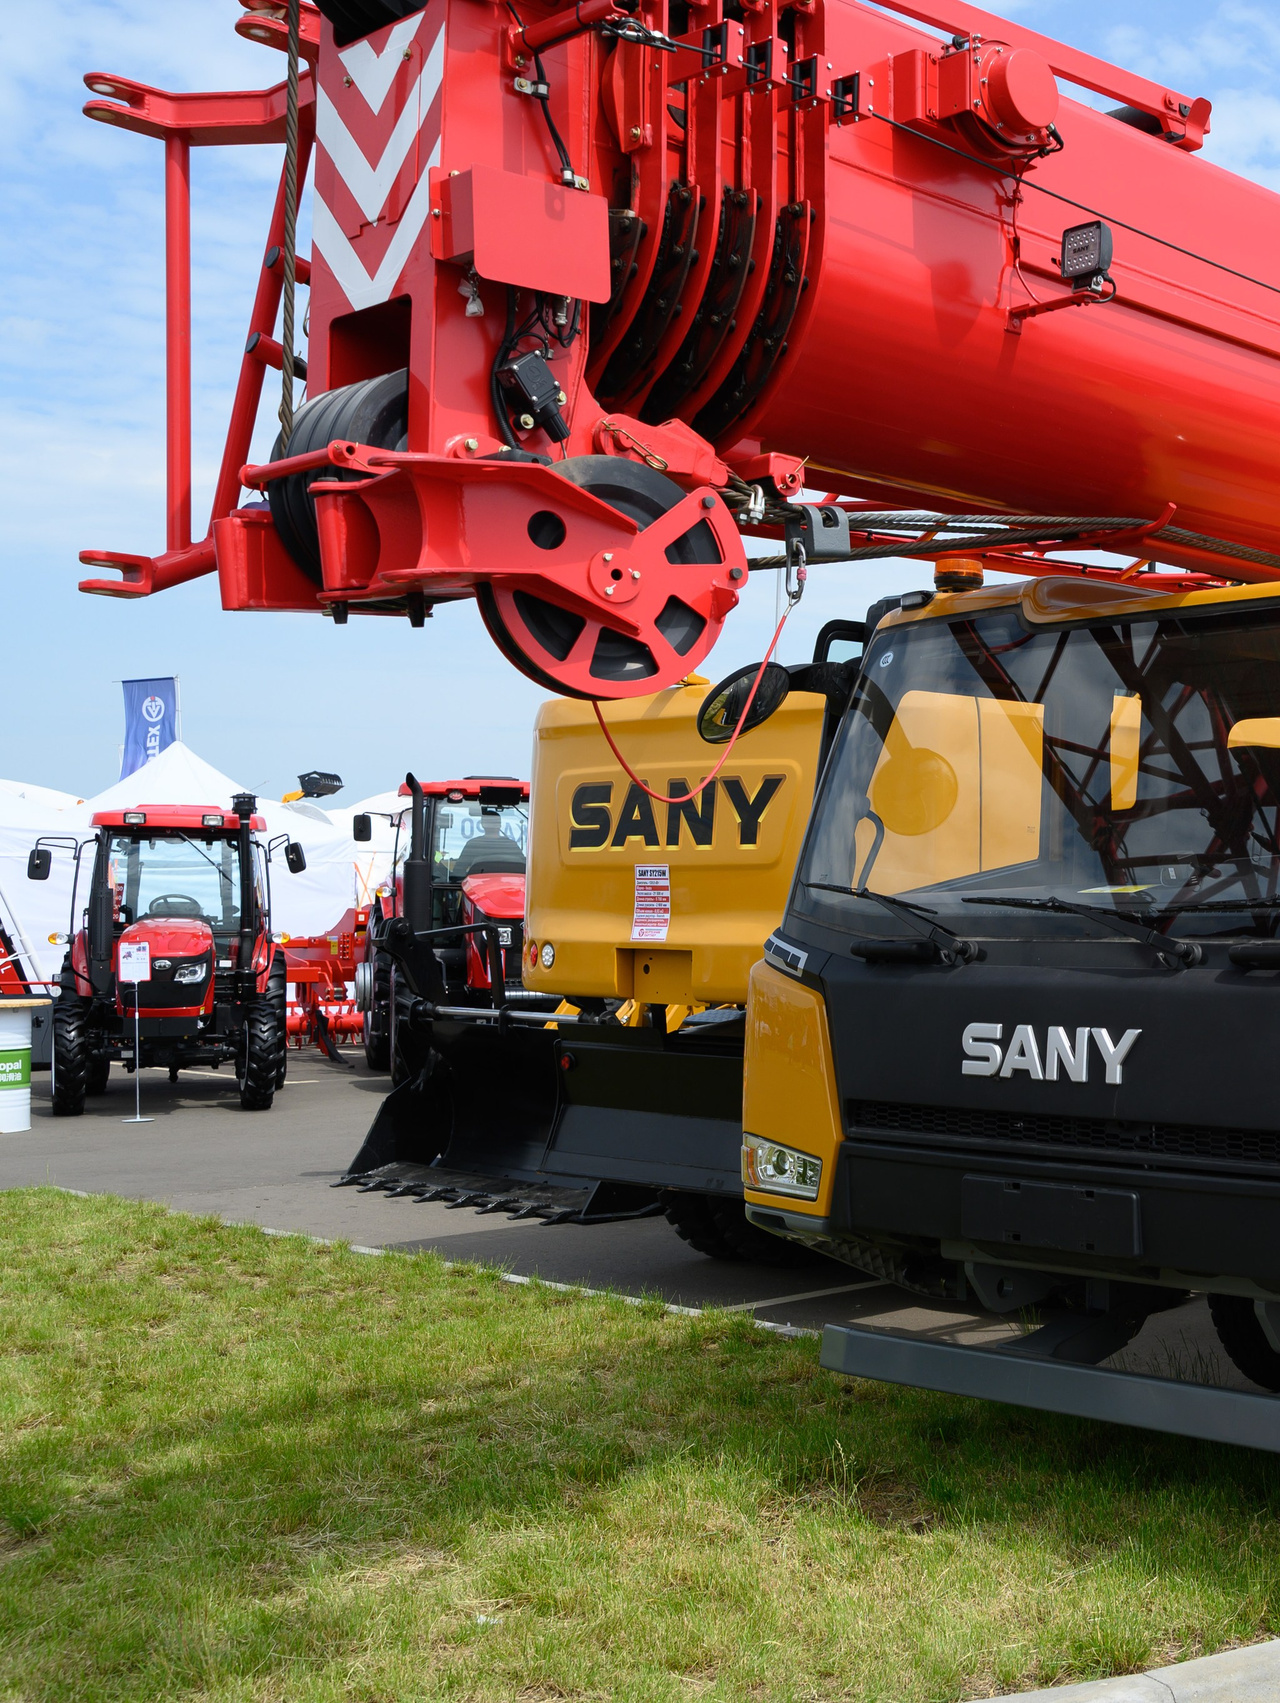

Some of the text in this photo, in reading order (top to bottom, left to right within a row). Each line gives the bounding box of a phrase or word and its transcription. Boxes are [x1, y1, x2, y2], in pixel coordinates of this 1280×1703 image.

[1072, 245, 1089, 254] SANY
[569, 777, 787, 850] SANY
[962, 1022, 1142, 1086] SANY
